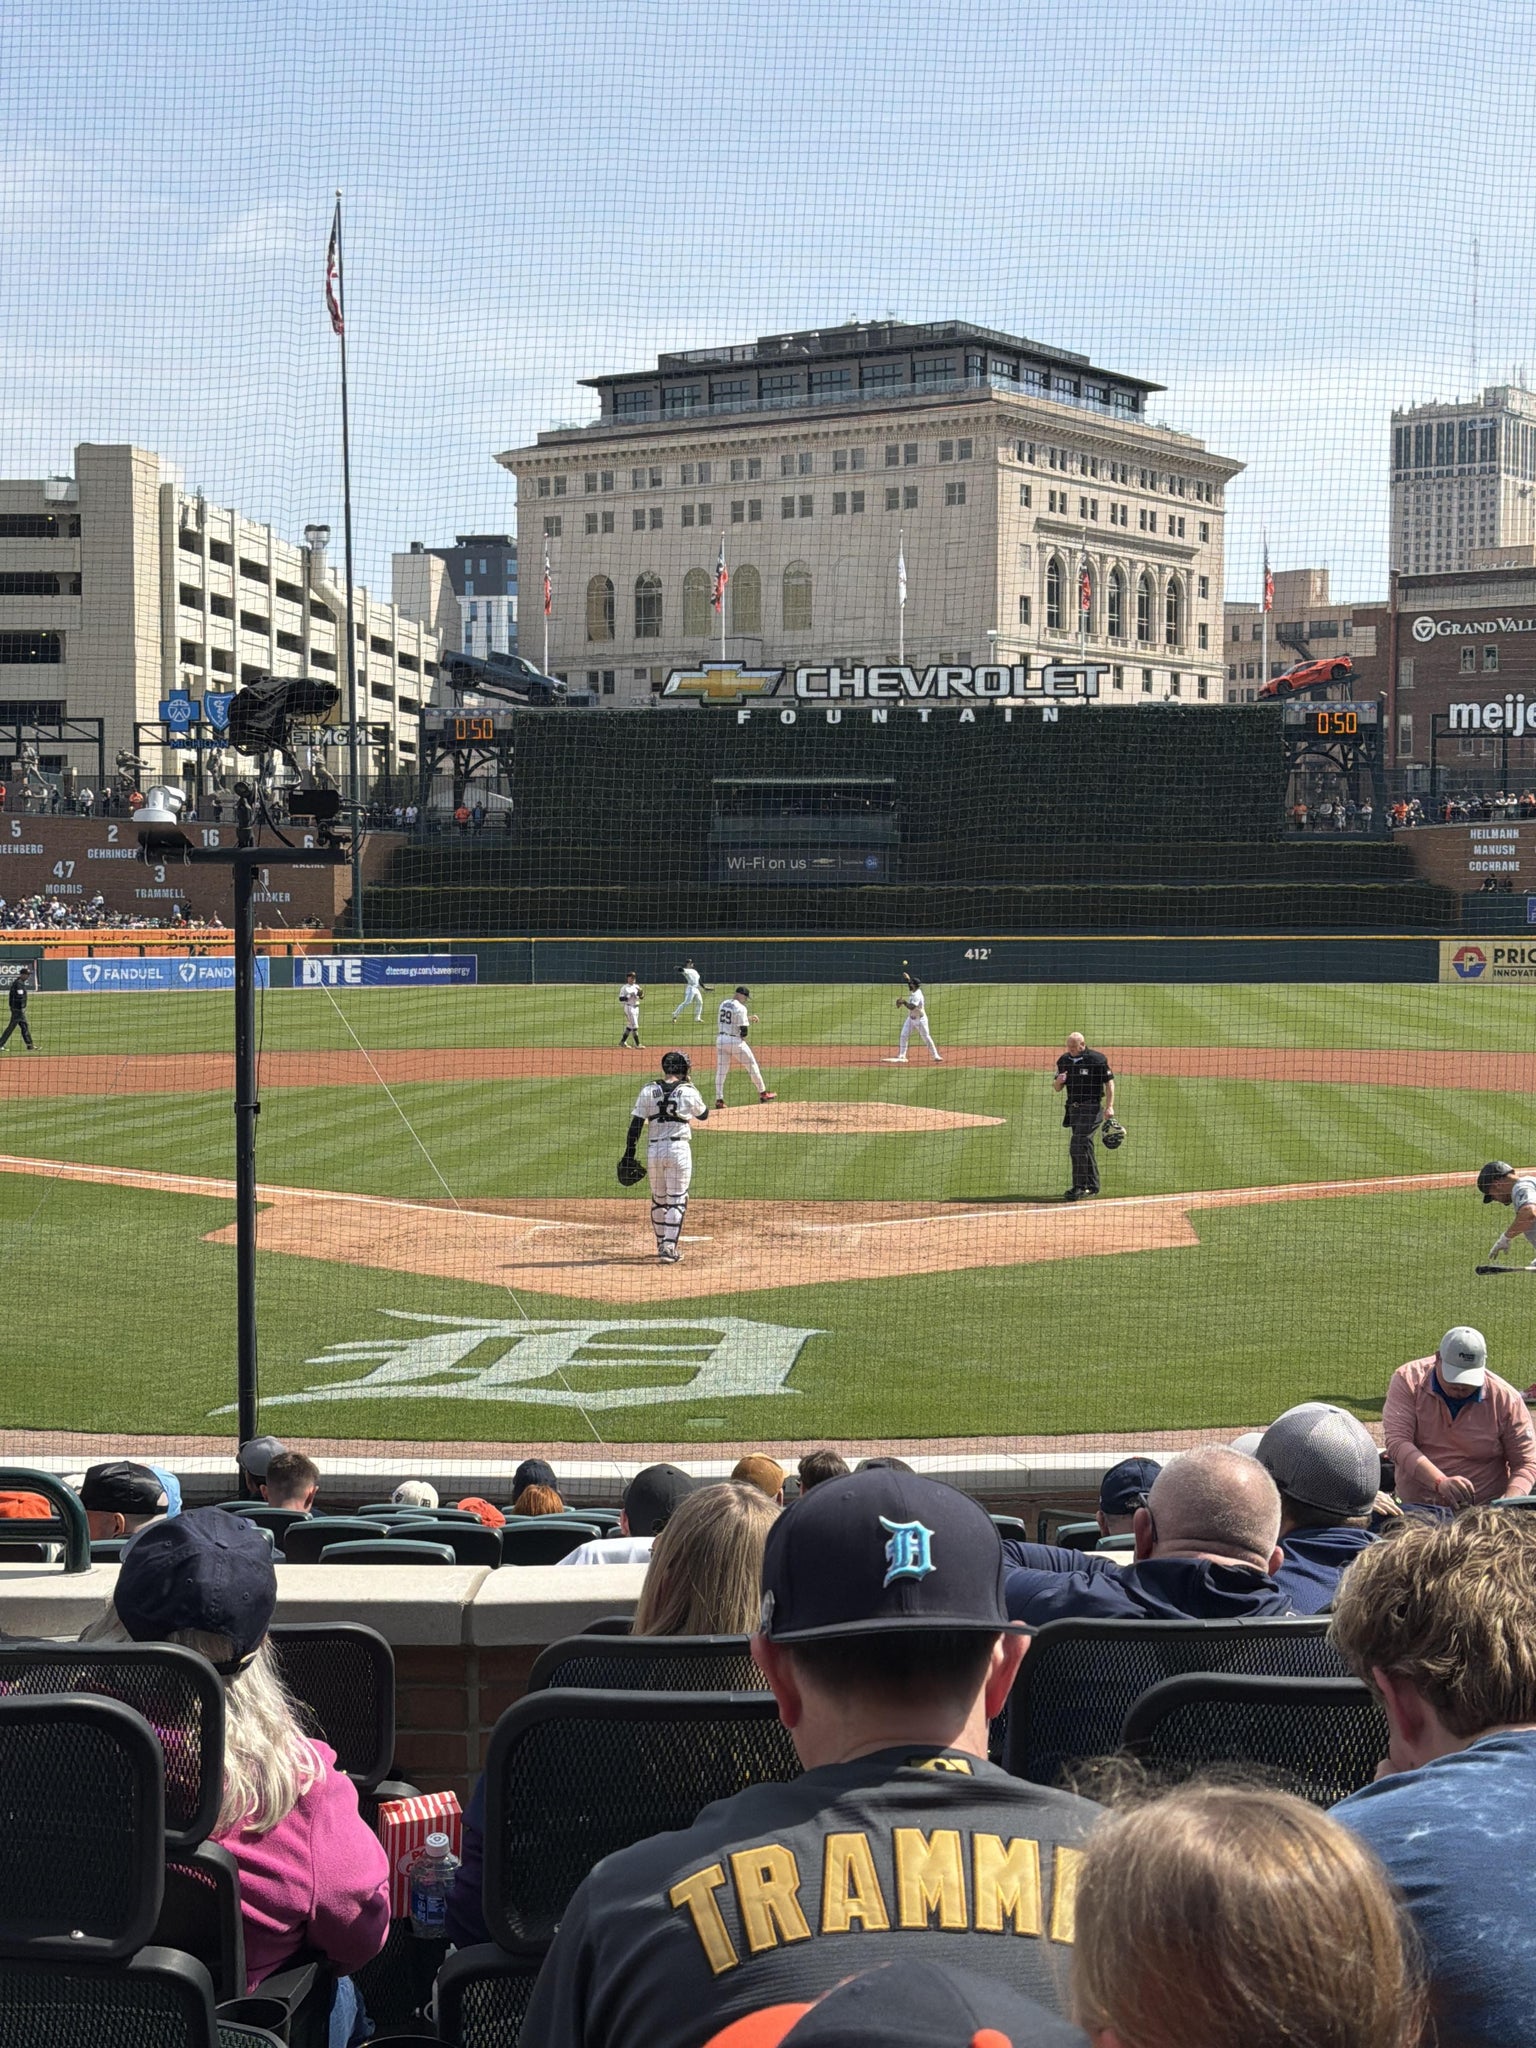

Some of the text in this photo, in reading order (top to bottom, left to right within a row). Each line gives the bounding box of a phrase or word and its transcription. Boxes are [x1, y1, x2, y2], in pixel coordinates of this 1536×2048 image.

[1436, 620, 1497, 636] GRAND
[795, 665, 1110, 698] CHEVROLET
[737, 707, 1059, 725] FOUNTAIN
[1317, 711, 1357, 735] 0:50
[169, 738, 230, 749] MICHIGAN
[11, 820, 22, 838] 5
[107, 824, 118, 843] 2
[1469, 828, 1520, 839] HEILMANN
[201, 828, 219, 847] 16
[303, 834, 314, 848] 6
[1473, 844, 1516, 855] MANUSH
[52, 860, 75, 878] 47
[727, 856, 807, 870] Wi-Fi on us
[1468, 861, 1520, 872] COCHRANE
[154, 864, 166, 883] 3
[262, 868, 270, 887] 1
[45, 884, 83, 895] MORRIS
[135, 888, 186, 899] TRAMMELL
[964, 948, 992, 960] 412'
[104, 968, 164, 980] FANDUEL
[302, 959, 362, 985] DTE
[720, 1009, 732, 1025] 29
[878, 1515, 937, 1588] D
